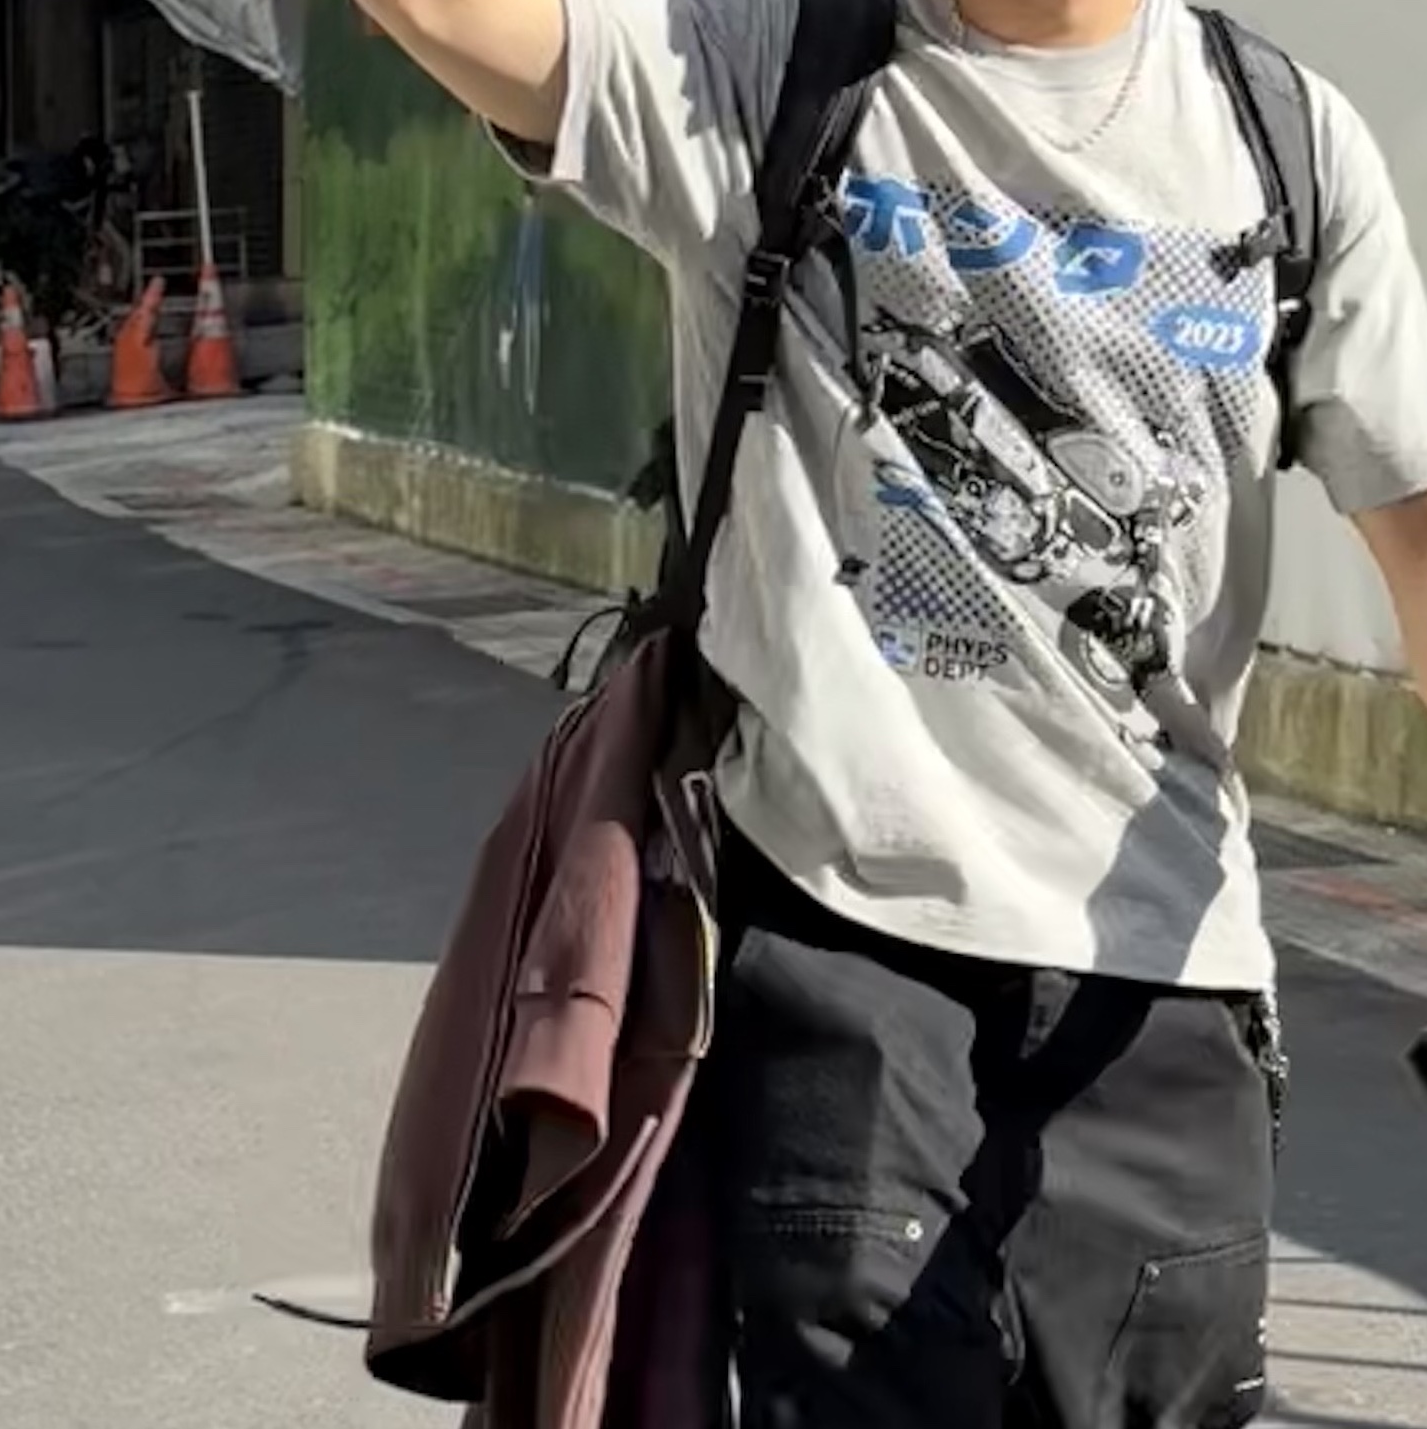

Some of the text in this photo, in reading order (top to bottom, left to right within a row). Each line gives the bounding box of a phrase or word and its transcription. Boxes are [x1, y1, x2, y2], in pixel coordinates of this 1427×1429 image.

[1173, 314, 1245, 354] 2023
[925, 632, 1008, 665] PHYPS
[924, 657, 989, 680] DEPT
